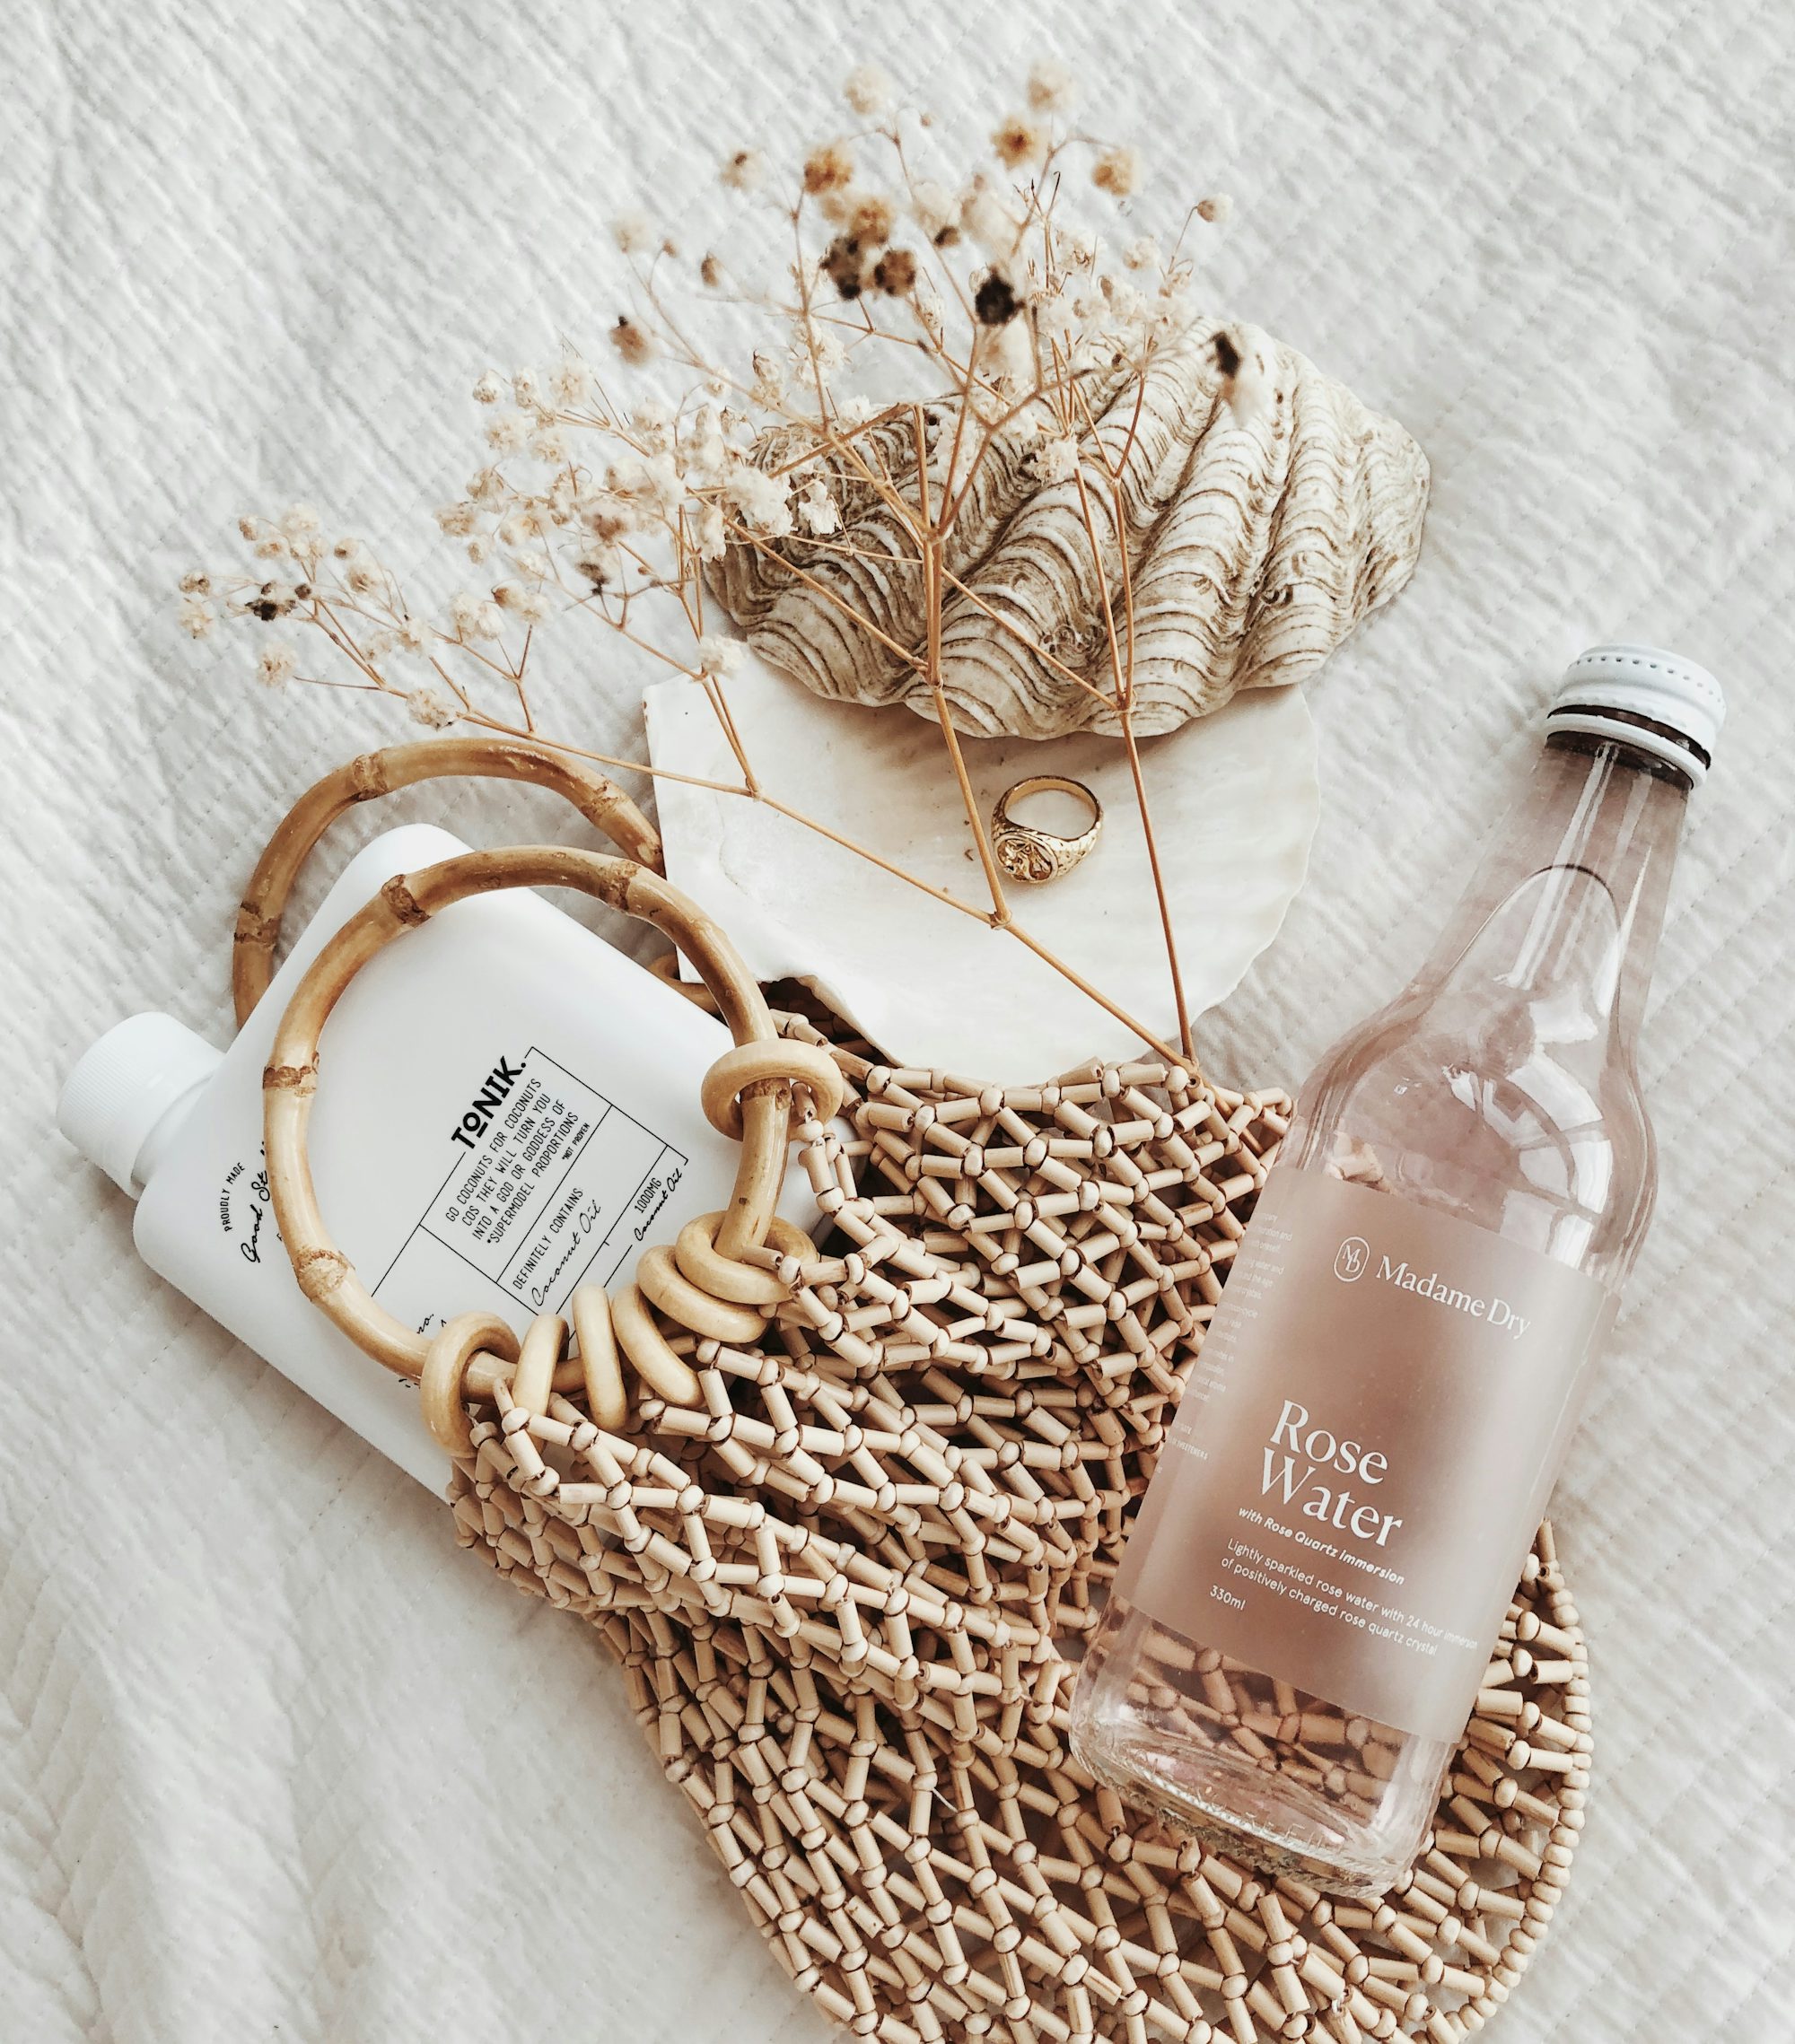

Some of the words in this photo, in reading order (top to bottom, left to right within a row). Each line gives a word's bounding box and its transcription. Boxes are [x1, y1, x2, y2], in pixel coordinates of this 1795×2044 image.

[451, 1055, 526, 1149] TONIK.
[531, 1113, 579, 1177] PROPORTIONS
[573, 1122, 591, 1146] PROVEN
[445, 1206, 460, 1222] GO
[456, 1155, 493, 1204] COCONUTS
[490, 1131, 507, 1152] FOR
[504, 1079, 541, 1129] COCONUTS
[461, 1205, 479, 1226] COS
[476, 1176, 497, 1202] THEY
[495, 1150, 517, 1174] WILL
[513, 1116, 536, 1144] TURN
[532, 1093, 551, 1114] YOU
[472, 1216, 492, 1240] INTO
[490, 1205, 499, 1215] A
[497, 1181, 514, 1202] GOD
[512, 1164, 526, 1179] OR
[522, 1116, 556, 1161] GODDESS
[553, 1099, 565, 1115] OF
[220, 1188, 232, 1232] PROUDLY
[226, 1162, 245, 1184] MADE
[241, 1204, 263, 1263] Good
[634, 1190, 668, 1242] Coconut
[666, 1167, 682, 1192] Oil
[635, 1177, 662, 1213] 1000MG
[512, 1235, 552, 1290] DEFINITELY
[549, 1188, 583, 1234] CONTAINS
[531, 1231, 581, 1306] Coconut
[580, 1199, 601, 1233] Oil
[1377, 1254, 1485, 1317] Madame
[1487, 1298, 1531, 1340] Dry
[1269, 1399, 1388, 1484] Rose
[1239, 1507, 1263, 1525] with
[1264, 1518, 1293, 1538] Rose
[1295, 1531, 1337, 1558] Quartz
[1260, 1446, 1403, 1547] Water
[1210, 1585, 1246, 1611] 330ml
[1221, 1557, 1232, 1568] of
[1233, 1562, 1287, 1595] positively
[1289, 1588, 1338, 1616] charged
[1339, 1609, 1366, 1629] rose
[1368, 1620, 1404, 1645] quartz
[1405, 1635, 1438, 1655] crystal
[1228, 1538, 1264, 1565] Lightly
[1264, 1556, 1314, 1585] sparkled
[1316, 1579, 1343, 1598] rose
[1346, 1592, 1379, 1612] water
[1380, 1604, 1404, 1624] with
[1405, 1615, 1420, 1628] 24
[1421, 1618, 1443, 1638] hour
